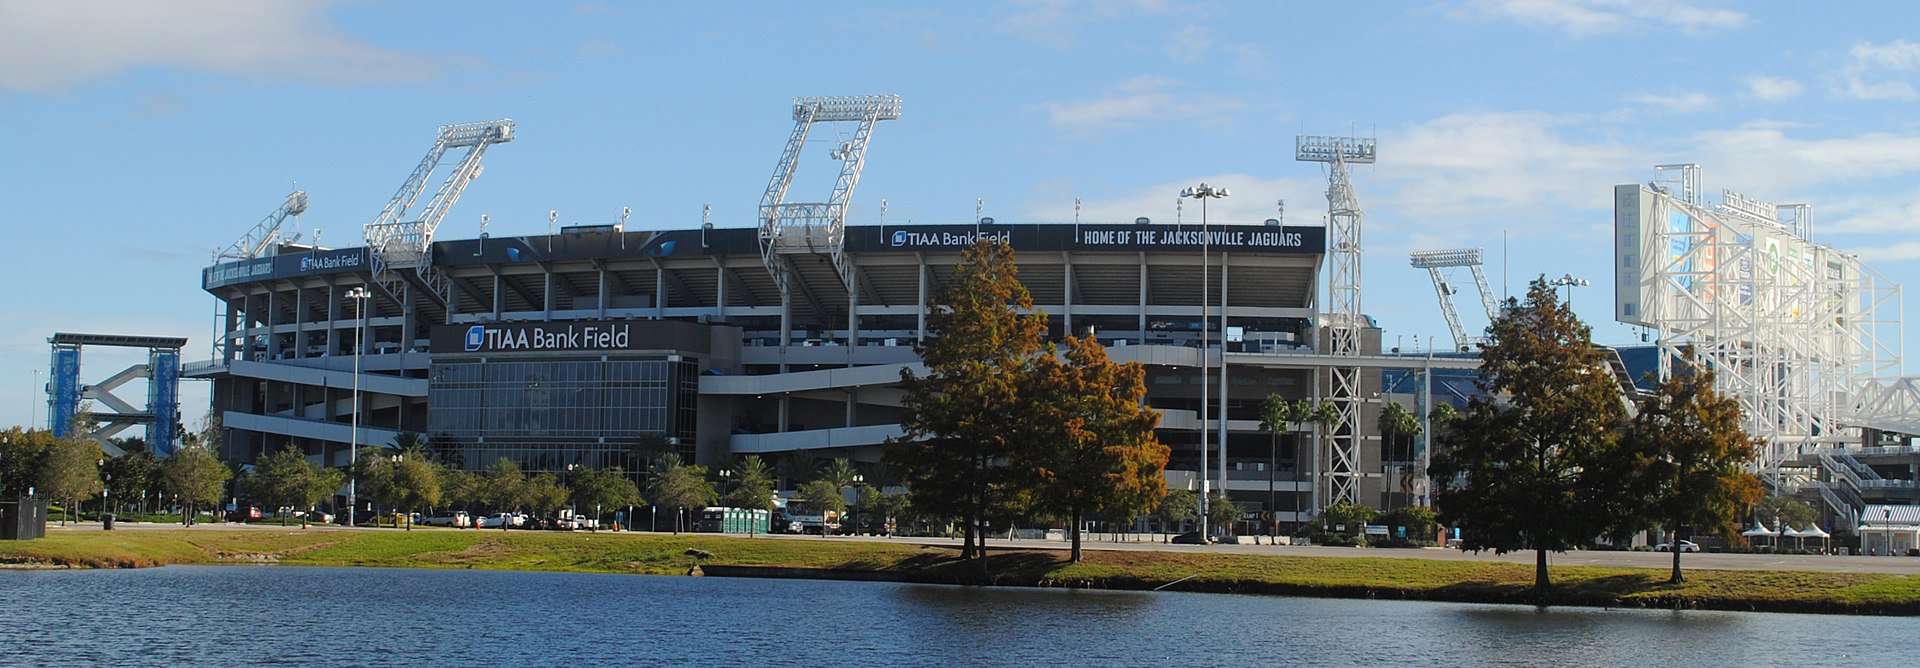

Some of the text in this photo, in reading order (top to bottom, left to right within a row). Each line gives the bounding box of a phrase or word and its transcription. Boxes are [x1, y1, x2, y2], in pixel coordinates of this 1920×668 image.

[907, 230, 1010, 246] TIAA Bank Field
[1084, 231, 1302, 247] HOME OF THE JACKSONVILLE JAGUARS
[308, 253, 359, 270] TIAA Bank Field
[485, 324, 629, 349] TIAA Bank Field
